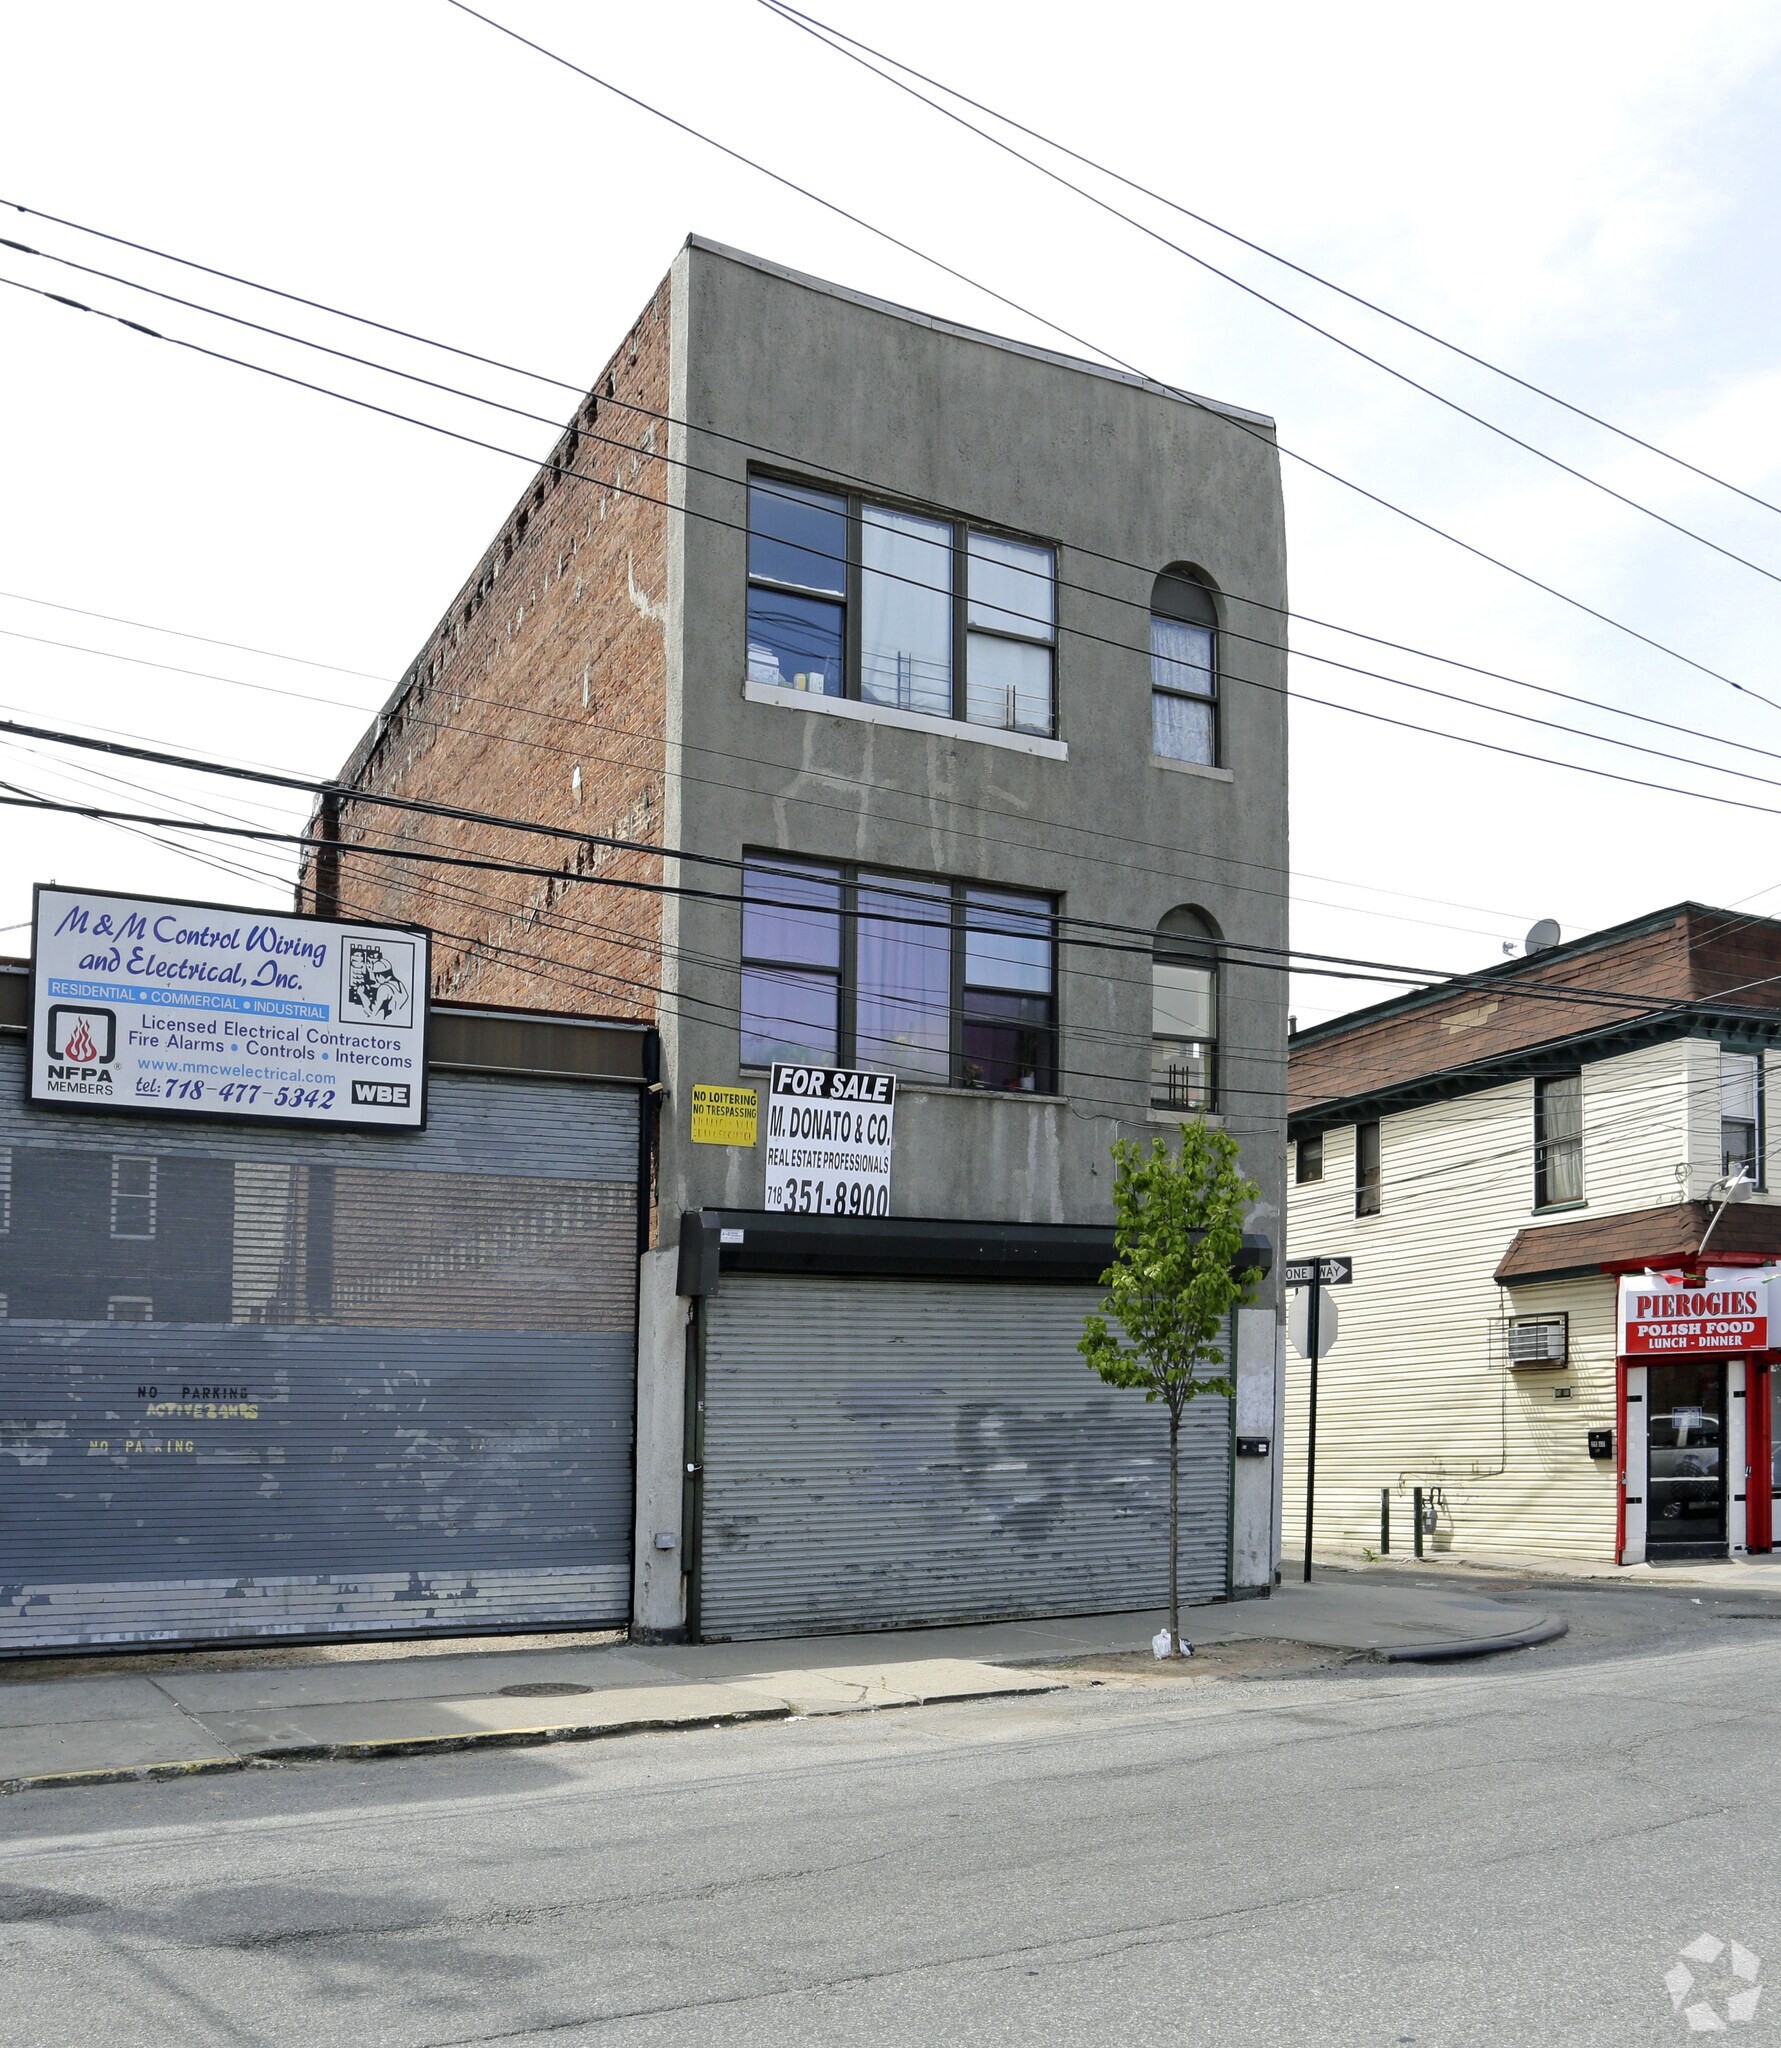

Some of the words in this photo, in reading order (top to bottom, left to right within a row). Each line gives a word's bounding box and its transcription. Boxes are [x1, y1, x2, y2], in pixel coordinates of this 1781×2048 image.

[54, 905, 90, 937] M
[92, 914, 114, 936] &
[112, 912, 148, 943] M
[153, 915, 241, 949] Control
[245, 925, 327, 968] Wiring
[78, 946, 121, 973] and
[126, 945, 247, 987] Electrical,
[250, 959, 303, 990] Inc.
[52, 982, 136, 1001] RESIDENTIAL
[150, 991, 240, 1010] COMMERCIAL
[253, 1000, 327, 1019] INDUSTRIAL
[142, 1014, 217, 1035] Licensed
[224, 1021, 300, 1042] Electrical
[306, 1028, 402, 1051] Contractors
[128, 1030, 160, 1048] Fire
[167, 1034, 225, 1053] Alarms
[246, 1040, 316, 1061] Controls
[335, 1048, 413, 1069] Intercoms
[47, 1065, 114, 1083] NFPA
[137, 1058, 337, 1085] www.mmcwelectrical.com
[776, 1067, 826, 1096] FOR
[830, 1073, 889, 1102] SALE
[47, 1081, 114, 1096] MEMBERS
[135, 1077, 161, 1097] tel:
[165, 1078, 337, 1110] 718-477-5342
[355, 1084, 409, 1105] WBE
[693, 1090, 707, 1102] NO
[709, 1092, 757, 1107] LOITERING
[692, 1103, 705, 1115] NO
[706, 1105, 757, 1119] TRESPASSING
[769, 1105, 786, 1138] M.
[789, 1106, 852, 1143] DONATO
[854, 1114, 864, 1144] &
[867, 1113, 891, 1146] CO.
[767, 1147, 790, 1167] REAL
[791, 1149, 822, 1169] ESTATE
[822, 1151, 889, 1174] PROFESSIONALS
[767, 1185, 783, 1205] 718
[783, 1177, 889, 1217] 351-8900
[1286, 1268, 1308, 1279] ONE
[1636, 1291, 1757, 1318] PIEROGIES
[1637, 1323, 1701, 1337] POLISH
[1706, 1321, 1755, 1334] FOOD
[1648, 1336, 1688, 1350] LUNCH
[1698, 1335, 1743, 1348] DINNER
[137, 1386, 158, 1399] NO
[181, 1386, 249, 1400] PARKING
